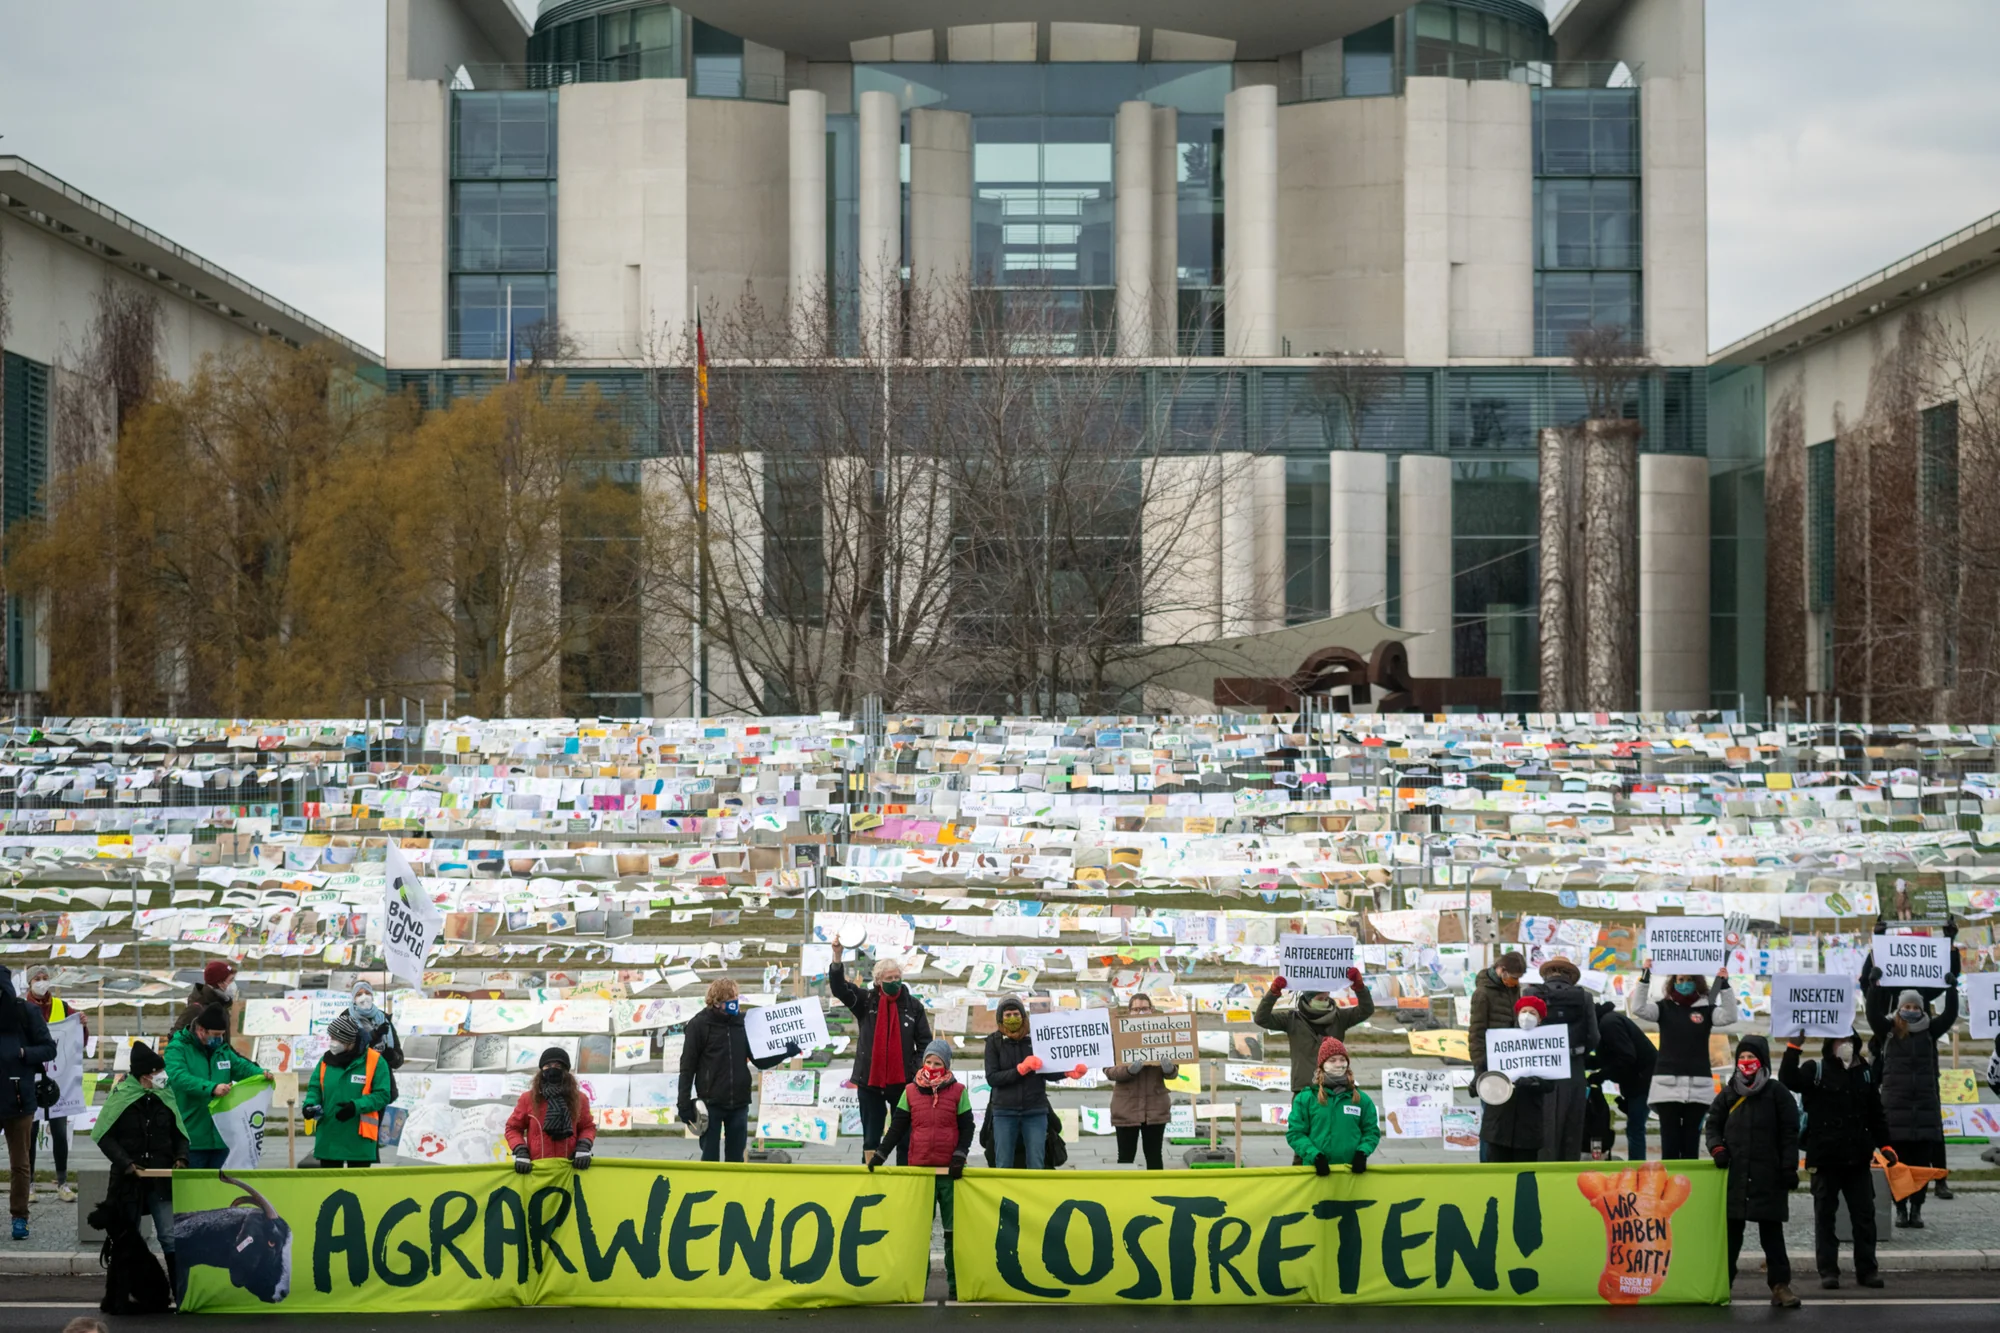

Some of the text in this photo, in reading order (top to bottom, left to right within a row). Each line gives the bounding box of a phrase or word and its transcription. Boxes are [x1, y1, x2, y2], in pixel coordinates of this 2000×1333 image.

[1650, 929, 1723, 943] ARTGERECHTE
[1284, 946, 1354, 960] ARTGERECHTE
[1651, 948, 1722, 962] TIERHALTUNG!
[1889, 943, 1938, 958] LASS DIE
[1885, 963, 1943, 979] SAU RAUS!
[1789, 988, 1844, 1003] INSEKTEN
[765, 1005, 803, 1022] BAUERN
[1792, 1009, 1839, 1024] RETTEN!
[769, 1019, 806, 1035] RECHTE
[1036, 1021, 1110, 1042] HÖFESTERBEN
[1120, 1016, 1192, 1033] Pastinaken
[1142, 1032, 1171, 1045] statt
[1494, 1036, 1566, 1054] AGRARWENDE
[1050, 1042, 1100, 1060] STOPPEN!
[1123, 1046, 1194, 1063] PESTiziden
[1499, 1054, 1562, 1071] LOSTRETEN!
[1388, 1078, 1428, 1093] ESSEN
[312, 1171, 1544, 1301] AGRARWENDE LOSTRETEN!
[1612, 1217, 1667, 1244] HABEN
[1610, 1245, 1671, 1277] ES SATT!
[1619, 1276, 1642, 1286] ESSEN
[1619, 1285, 1652, 1295] POLITISCH
